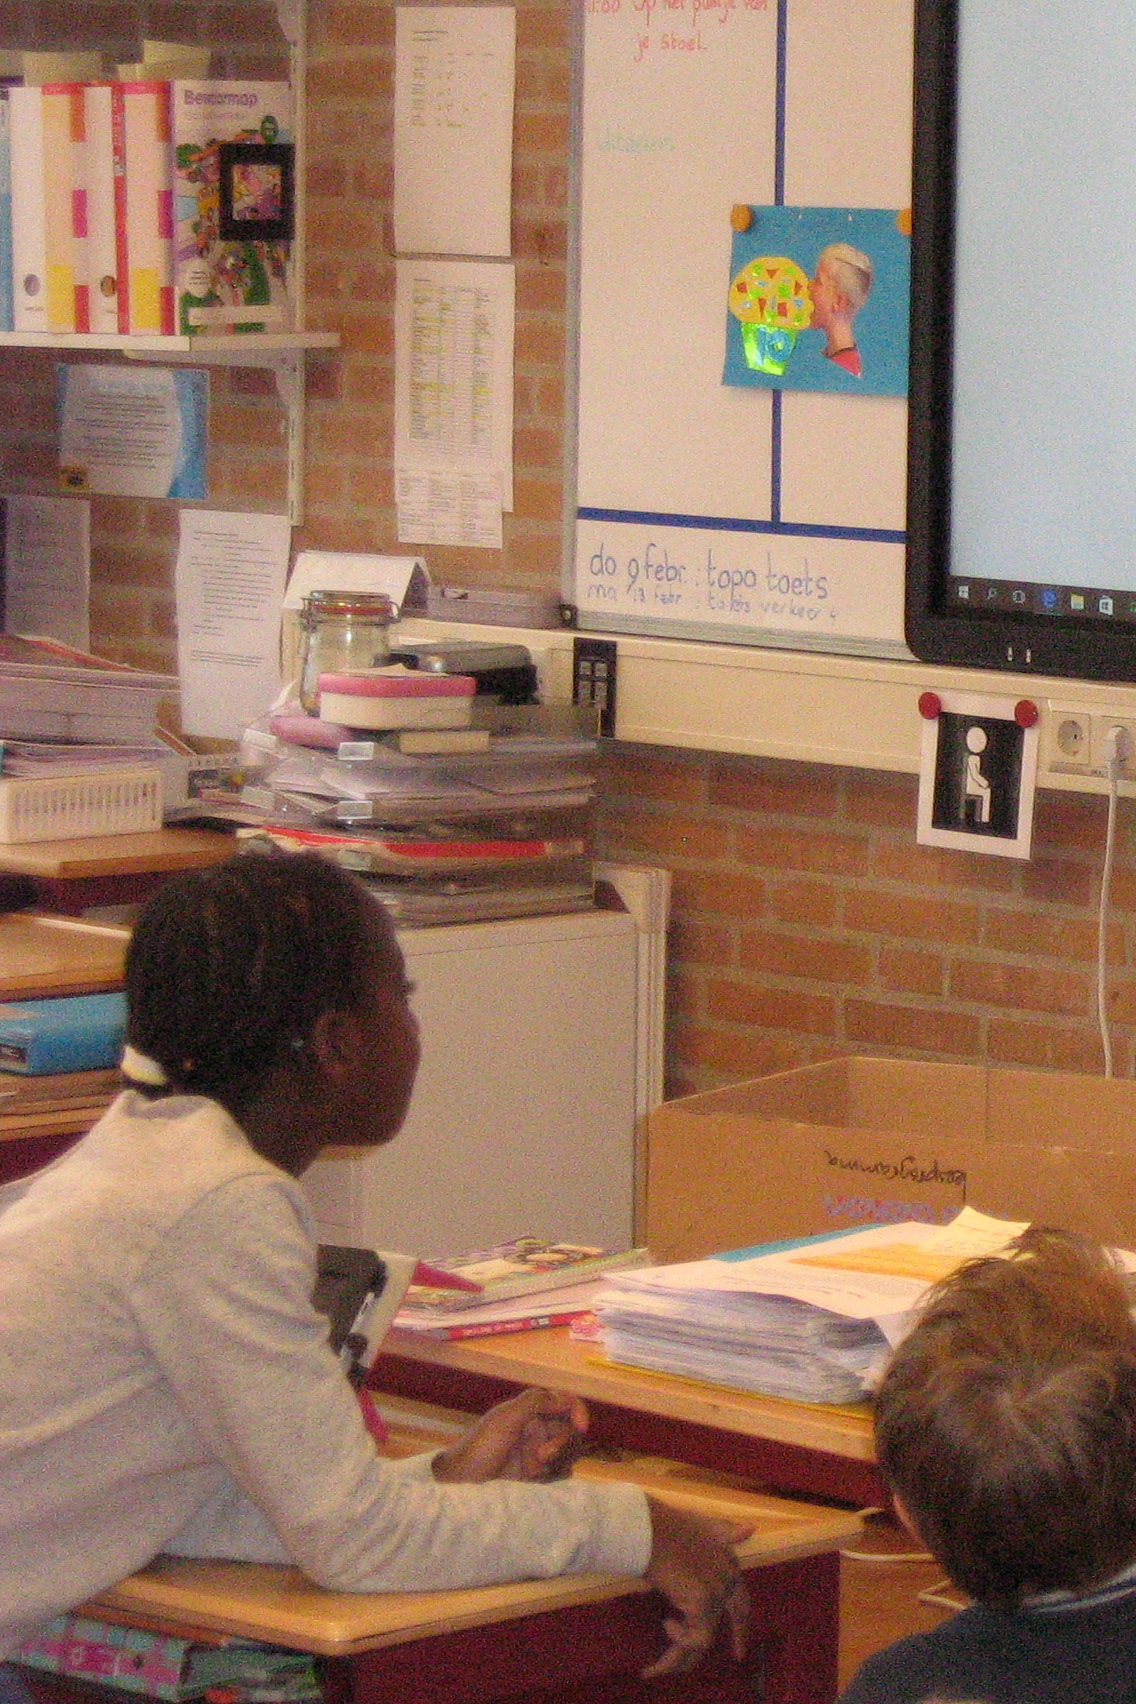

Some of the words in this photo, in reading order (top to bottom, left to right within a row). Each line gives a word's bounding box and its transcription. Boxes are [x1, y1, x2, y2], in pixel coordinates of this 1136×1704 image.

[590, 542, 617, 577] do
[706, 550, 757, 600] topo
[766, 552, 828, 600] toets
